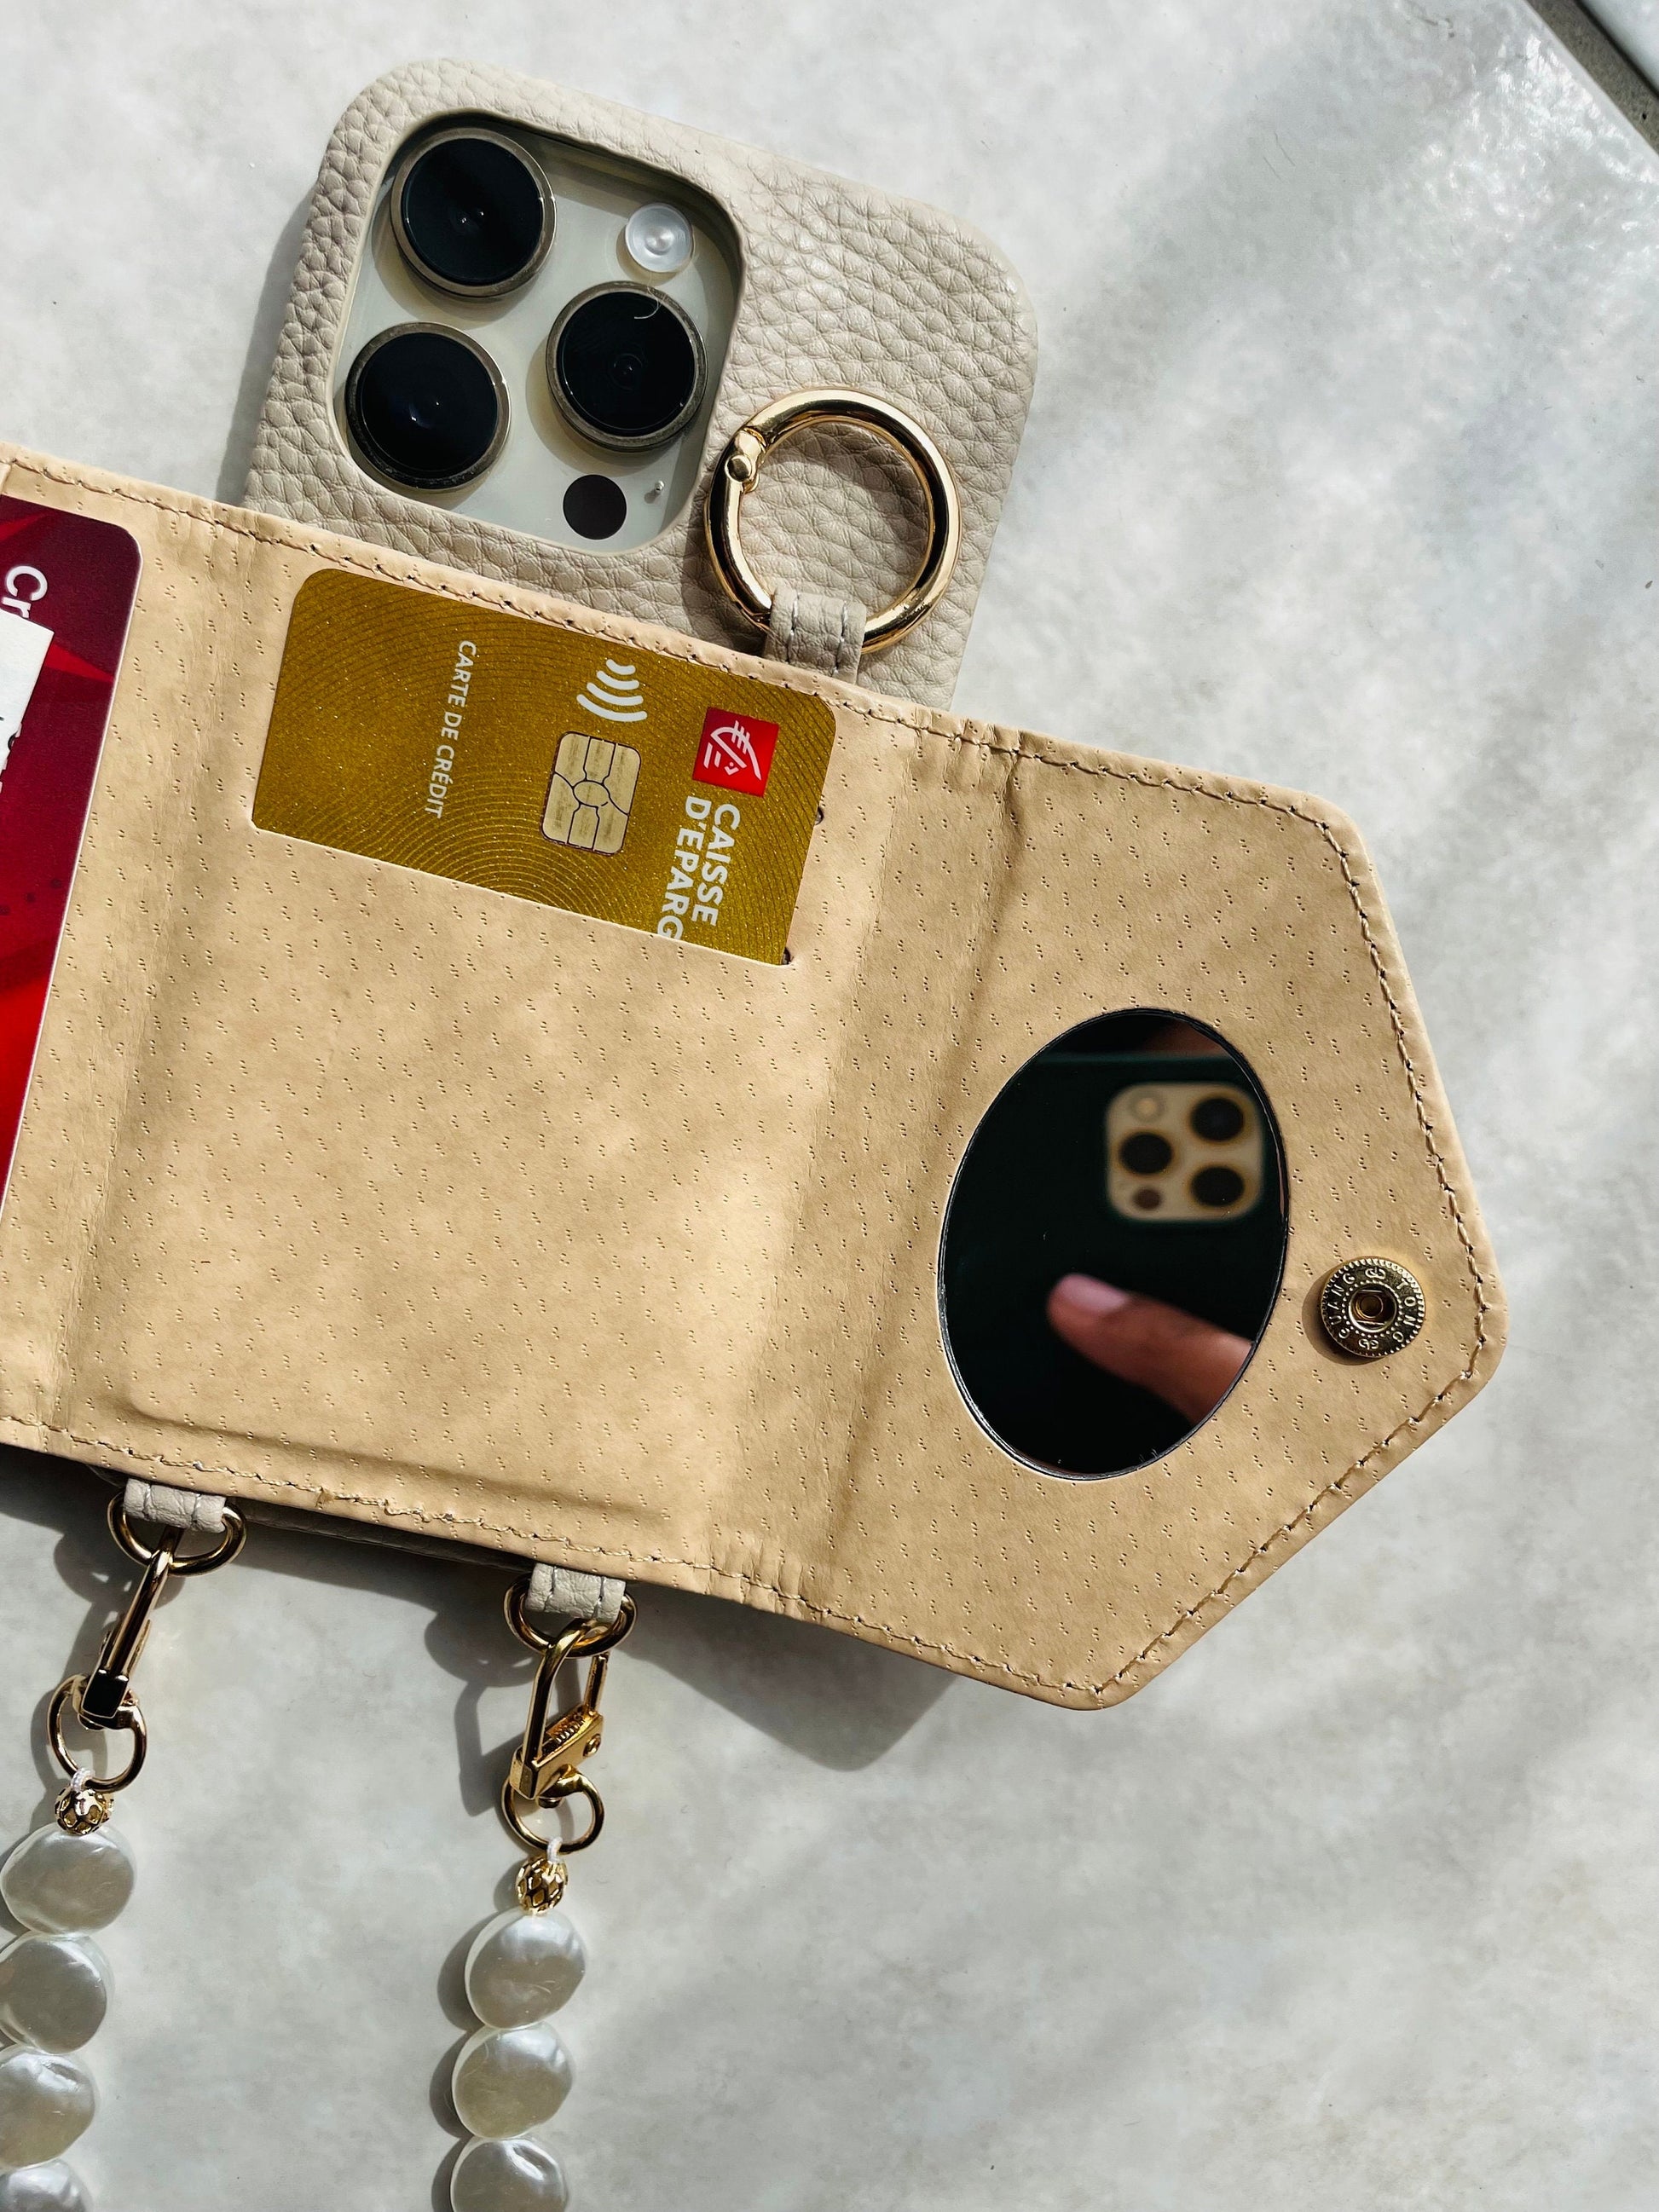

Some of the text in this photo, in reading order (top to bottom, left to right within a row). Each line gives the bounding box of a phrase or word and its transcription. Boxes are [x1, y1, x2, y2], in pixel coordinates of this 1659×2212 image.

[425, 640, 477, 819] CARTE DE CRÉDIT
[691, 803, 741, 927] CAISSE
